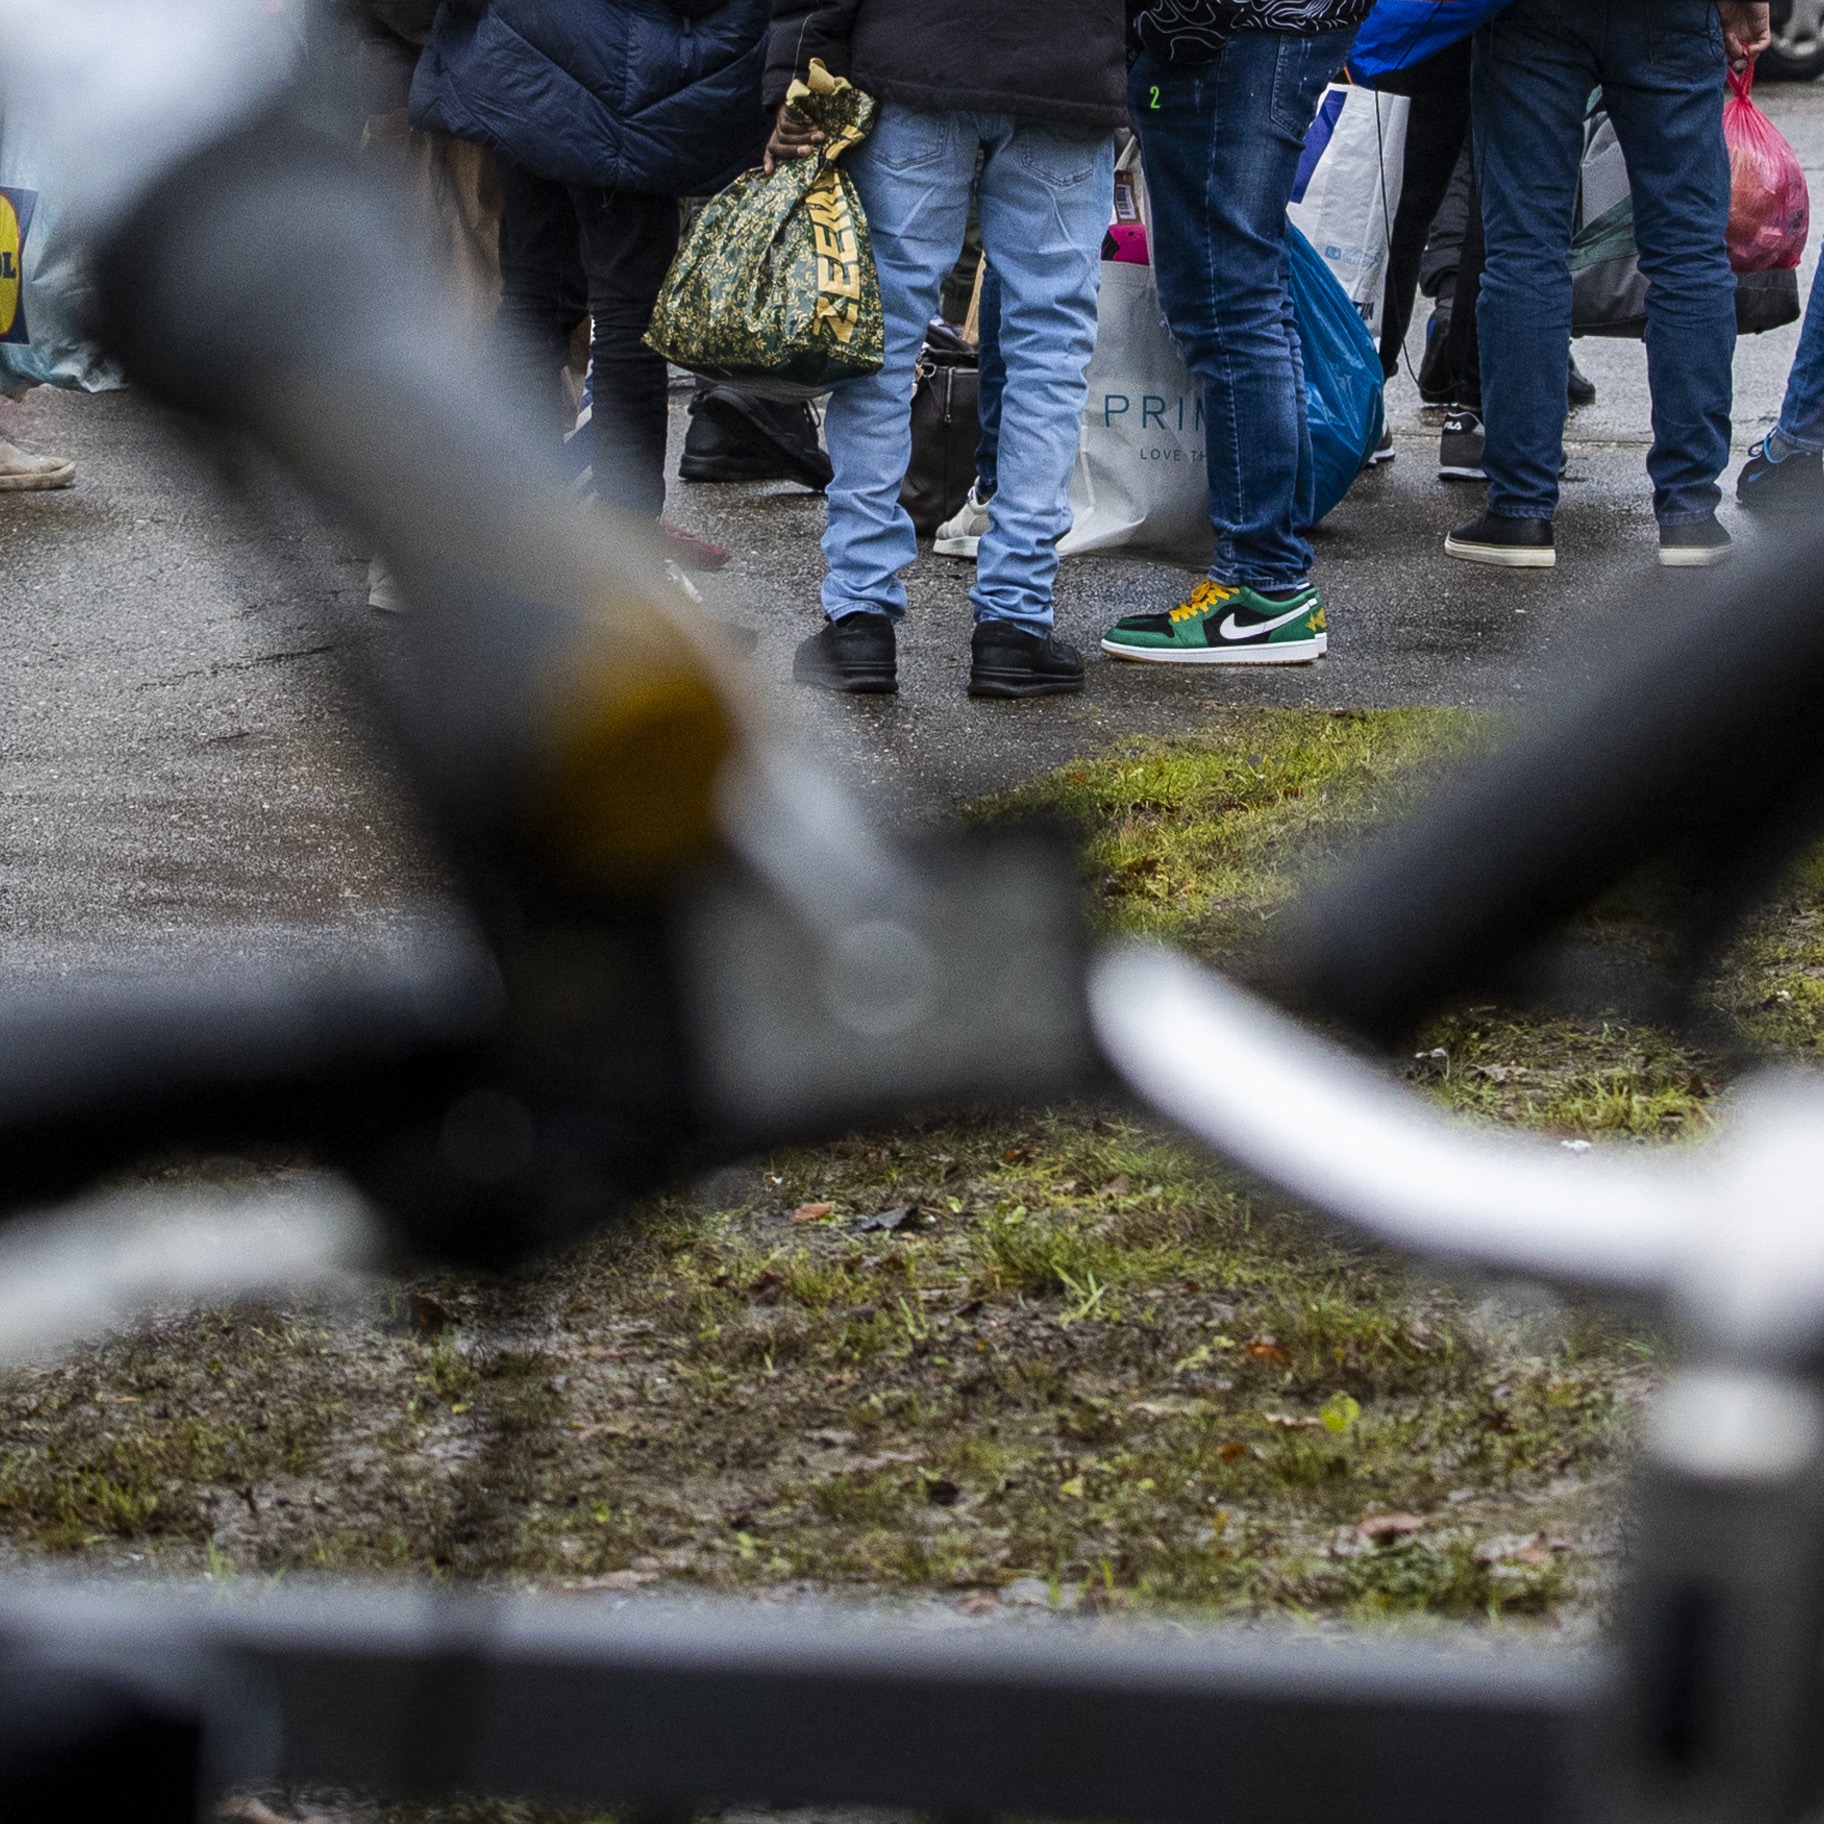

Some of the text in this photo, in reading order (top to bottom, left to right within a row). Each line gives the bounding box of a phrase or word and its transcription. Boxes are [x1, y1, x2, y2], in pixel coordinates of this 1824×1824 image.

[1149, 85, 1161, 110] 2
[805, 124, 866, 343] ZEEM
[1140, 448, 1181, 461] LOVE
